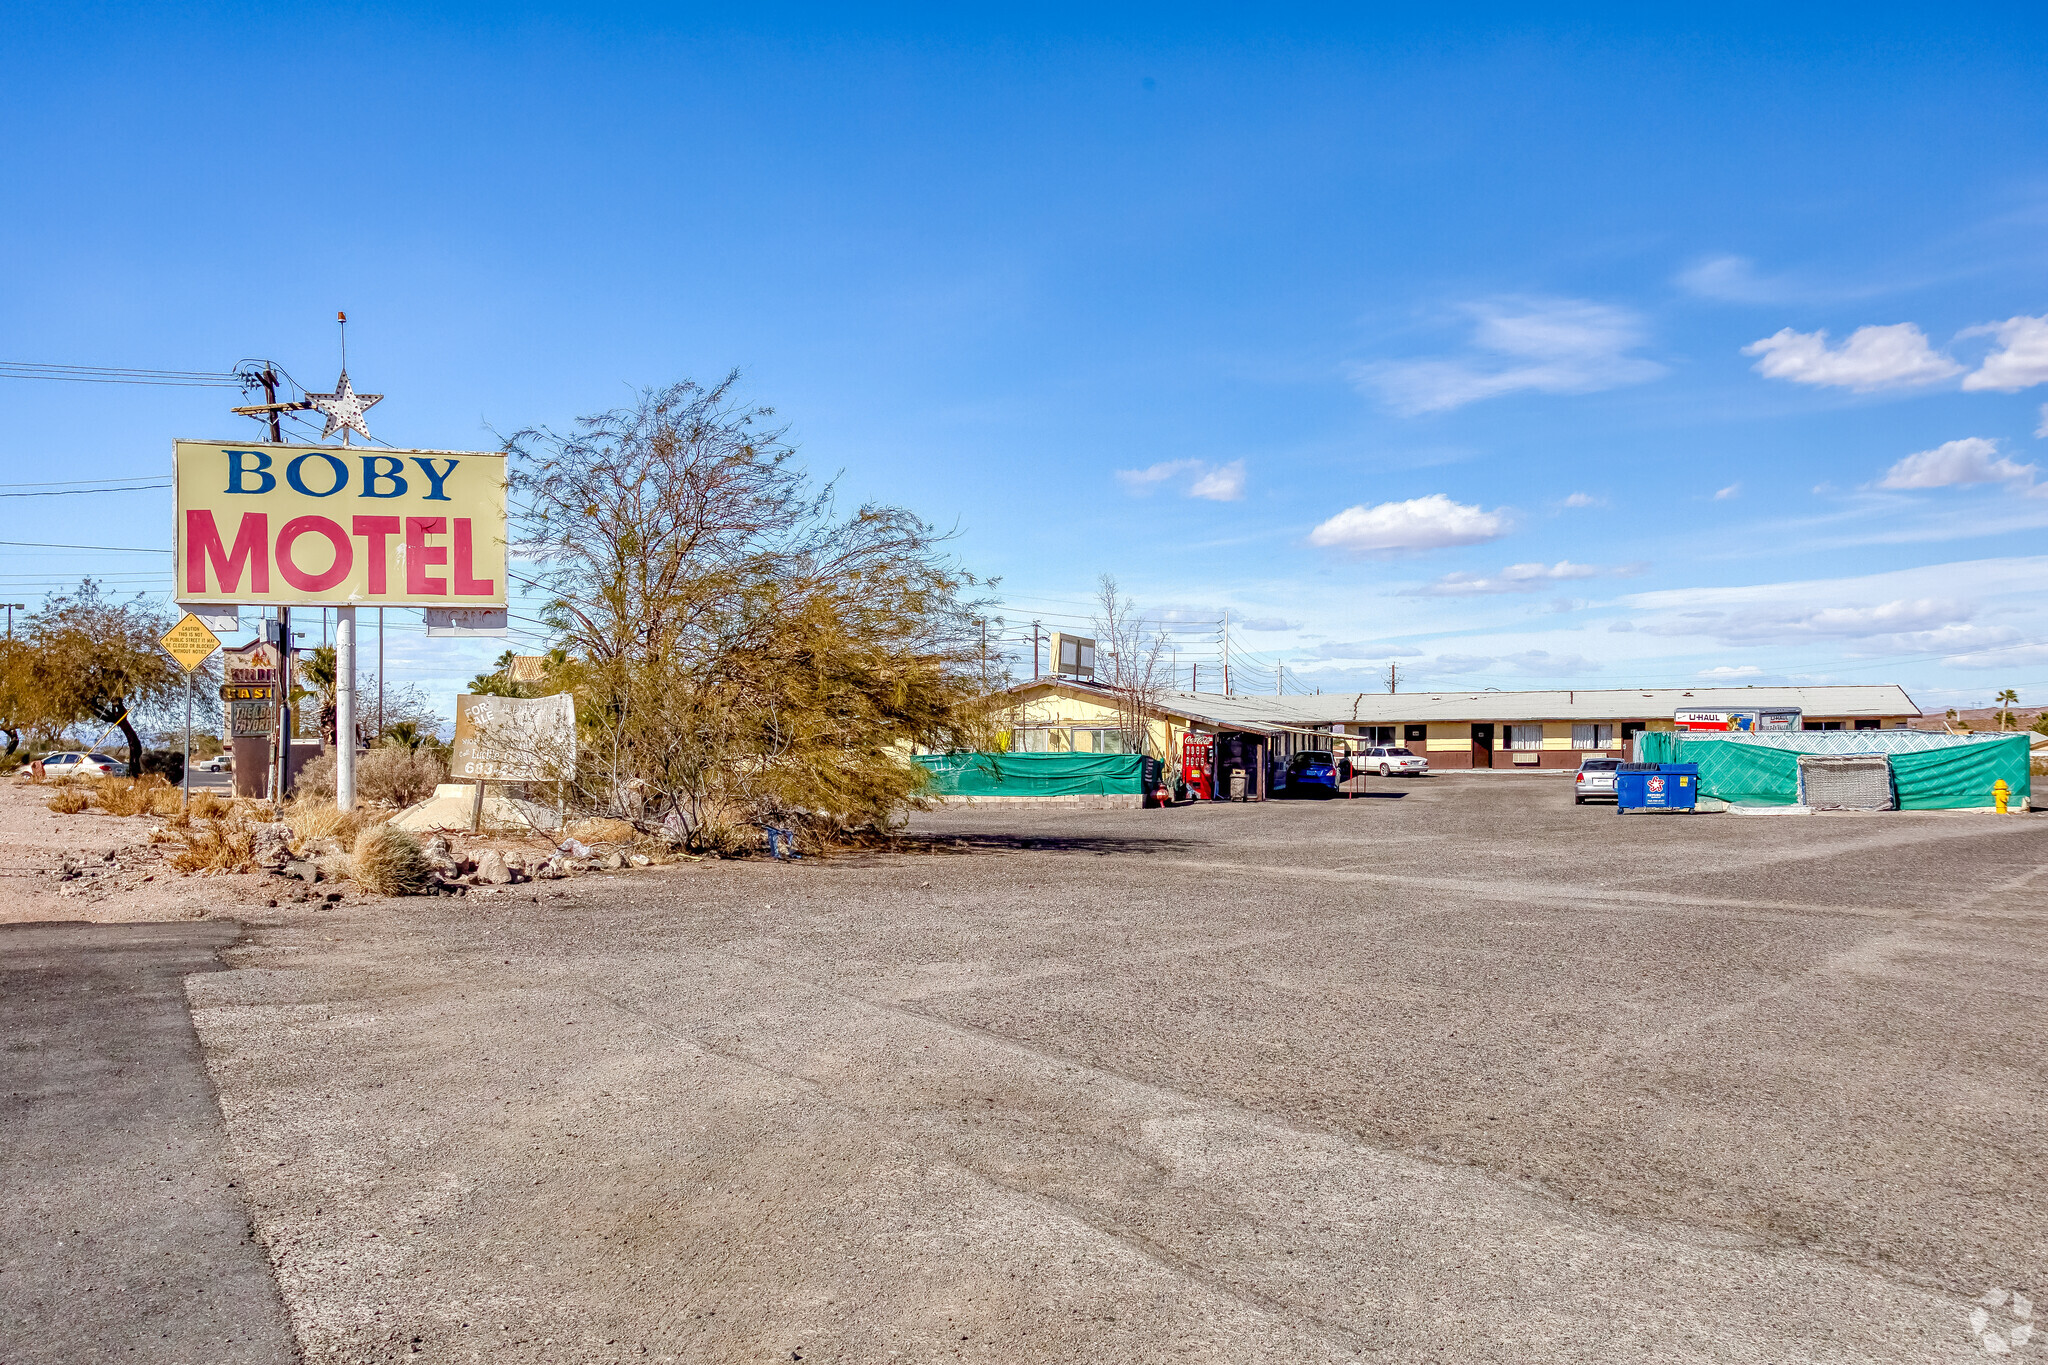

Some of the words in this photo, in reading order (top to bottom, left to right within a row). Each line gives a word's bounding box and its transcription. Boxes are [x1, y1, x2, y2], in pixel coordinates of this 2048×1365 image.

[222, 449, 460, 501] BOBY
[186, 509, 494, 596] MOTEL
[235, 707, 253, 719] THE
[464, 702, 489, 719] FOR
